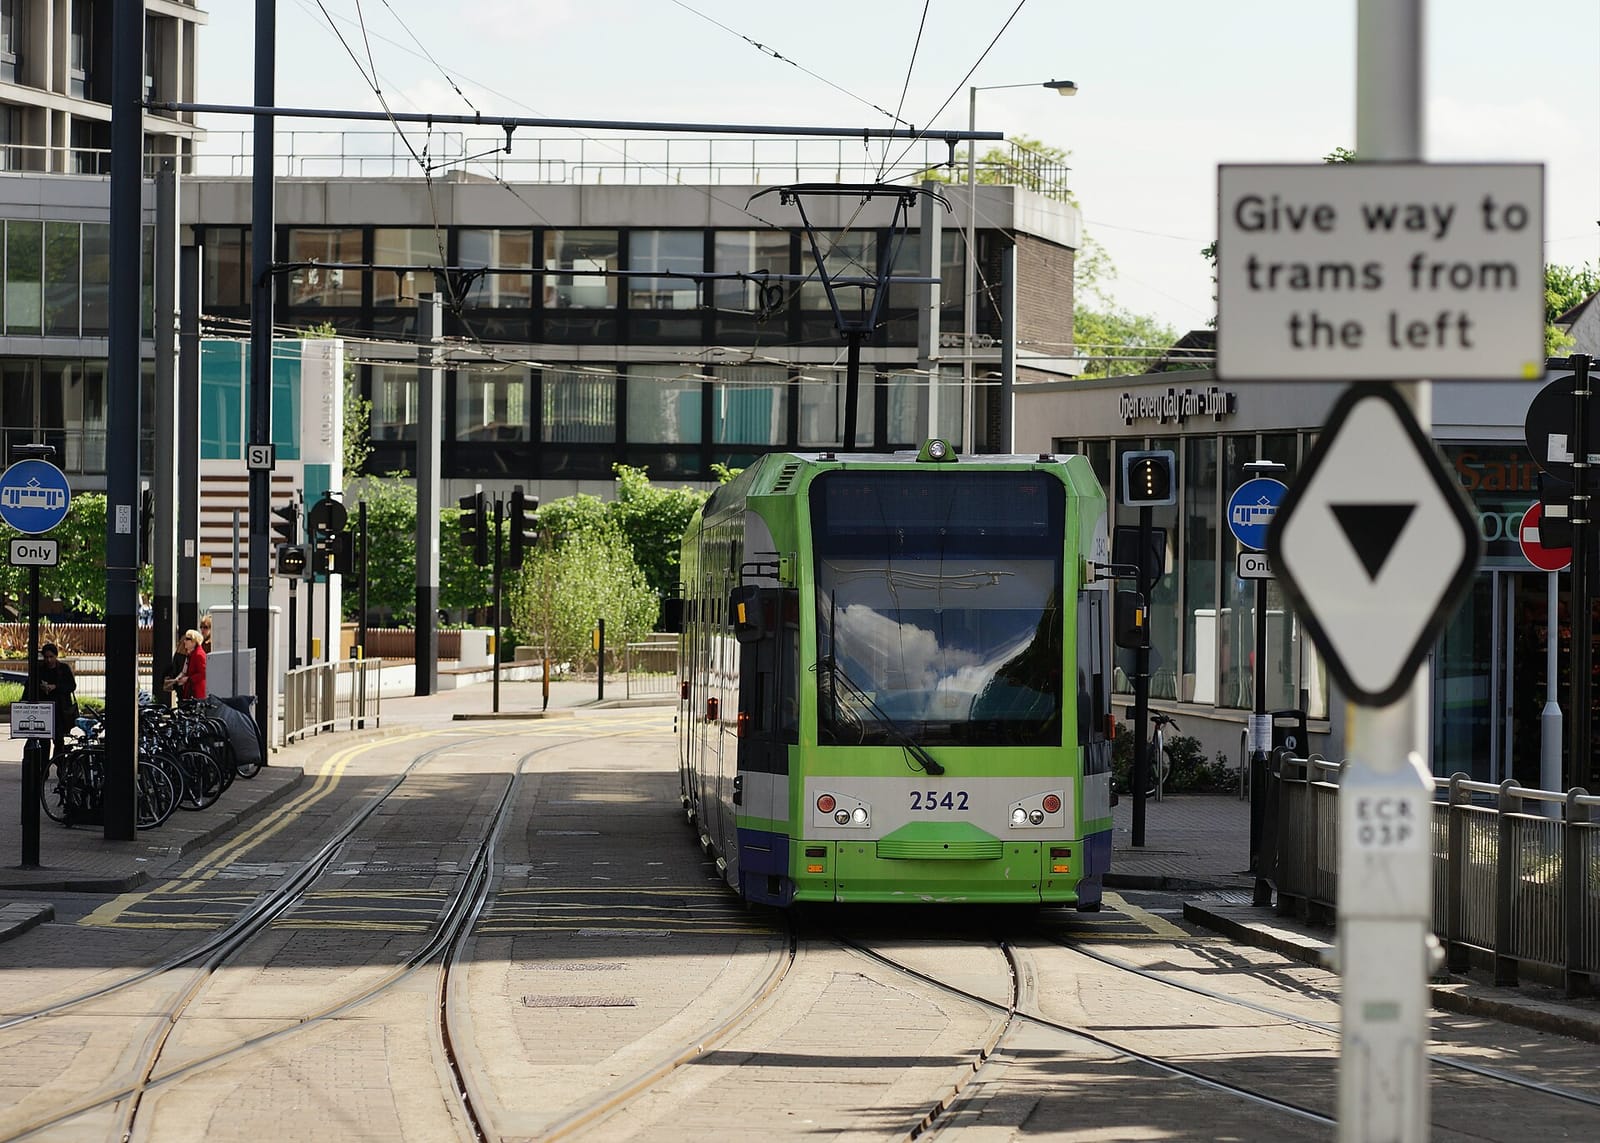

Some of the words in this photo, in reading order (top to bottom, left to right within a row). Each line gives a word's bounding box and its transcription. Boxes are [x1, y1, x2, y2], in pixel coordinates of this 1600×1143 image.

[1234, 195, 1336, 232] Give
[1362, 203, 1455, 240] way
[1481, 194, 1528, 232] to
[1246, 253, 1383, 291] trams
[1410, 251, 1518, 291] from
[1287, 309, 1363, 349] the
[1389, 309, 1474, 349] left
[1118, 393, 1139, 425] Open
[1140, 397, 1162, 425] every
[1163, 388, 1180, 424] day
[1181, 389, 1199, 415] 7am
[1205, 386, 1227, 422] 11pm
[252, 450, 269, 464] SI
[17, 545, 52, 560] Only
[1245, 559, 1273, 573] Onl
[910, 791, 969, 810] 2542
